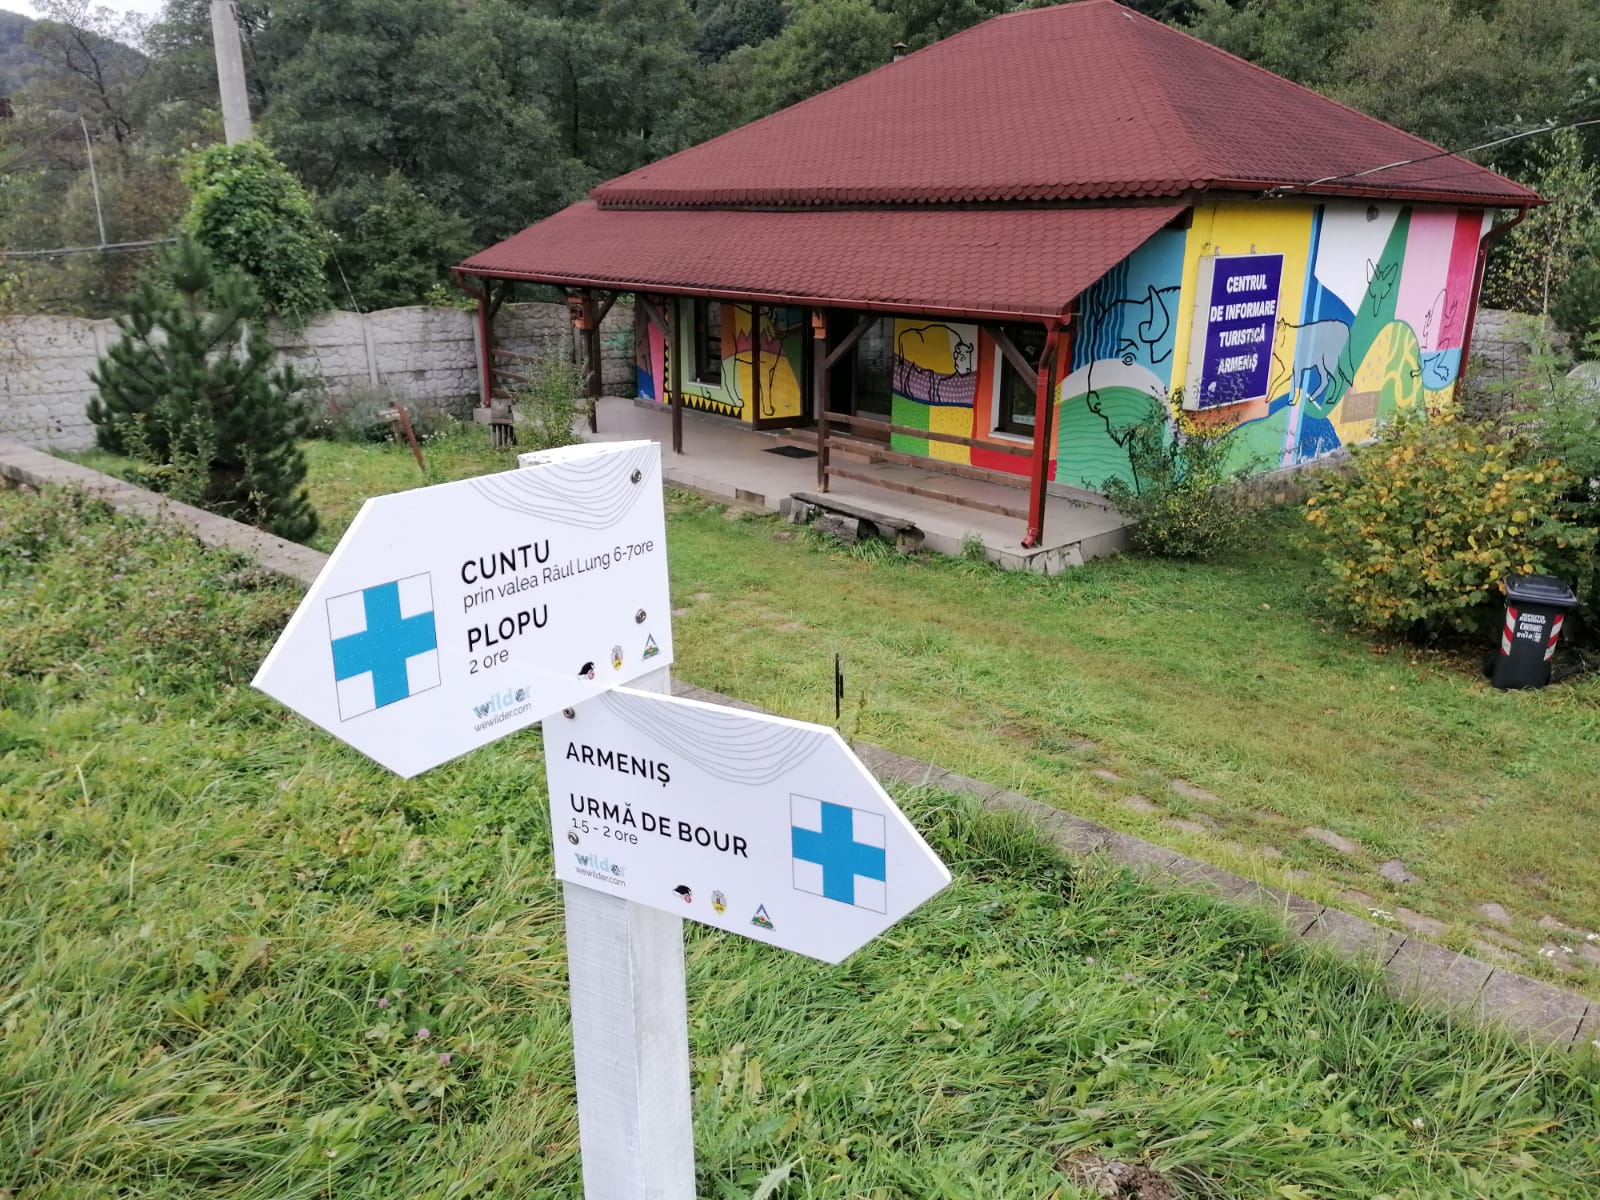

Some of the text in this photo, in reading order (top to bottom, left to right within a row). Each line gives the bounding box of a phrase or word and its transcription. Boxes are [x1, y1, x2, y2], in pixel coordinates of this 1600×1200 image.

[1226, 274, 1267, 293] CENTRUL
[1210, 300, 1276, 322] DE INFORMARE
[461, 539, 550, 584] CUNTU
[463, 586, 495, 613] prin
[497, 575, 539, 597] valea
[543, 559, 575, 584] Râul
[577, 552, 610, 574] Lung
[467, 604, 548, 652] PLOPU
[469, 649, 509, 674] 2 ore
[473, 685, 532, 718] wilder
[474, 702, 532, 732] wewilder.com
[566, 742, 671, 787] ARMENIȘ
[570, 793, 748, 858] URMĂ DE BOUR
[603, 826, 610, 837] 2
[614, 830, 638, 845] ore
[575, 867, 626, 887] wewilder.com
